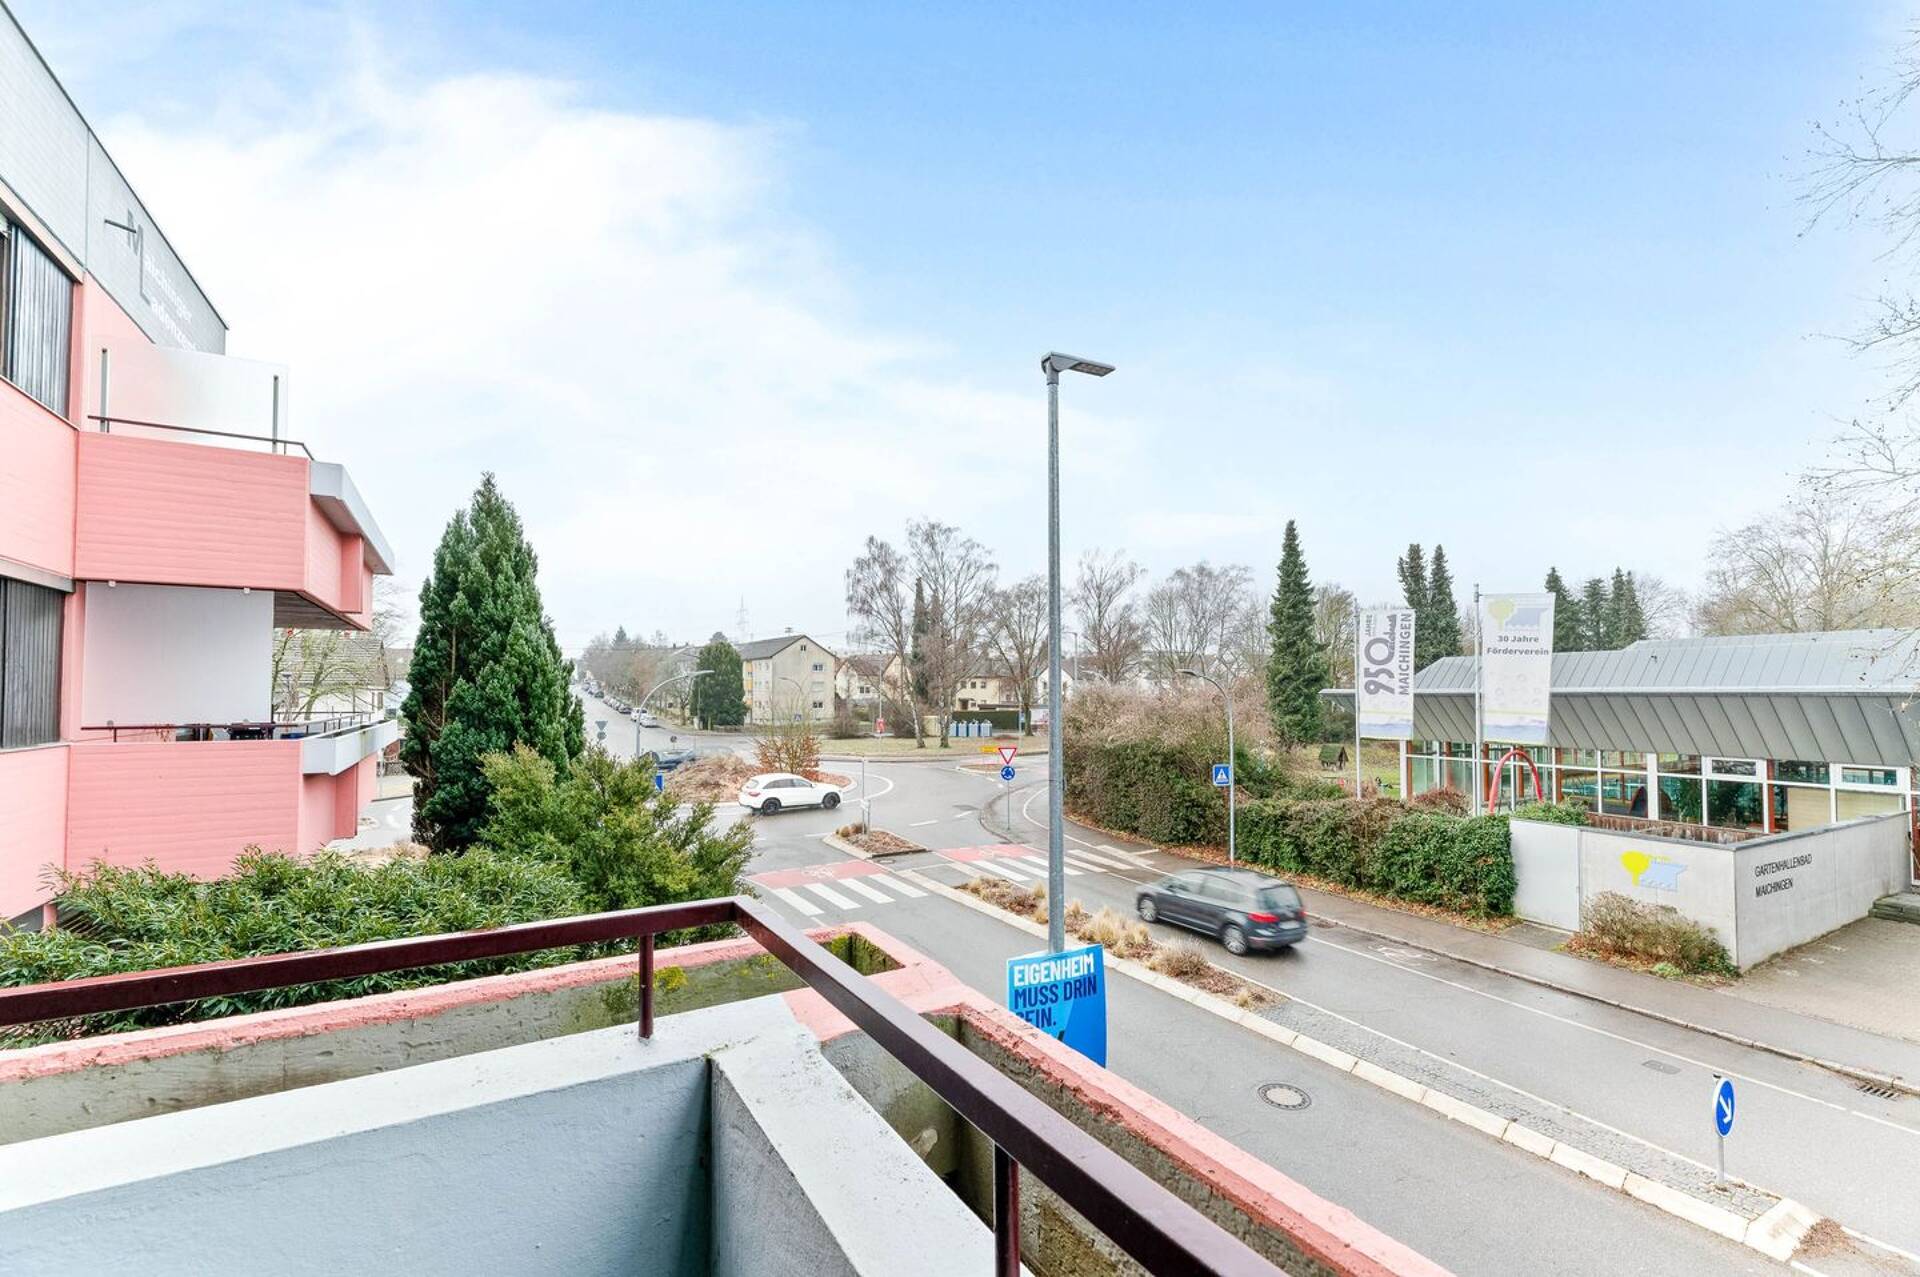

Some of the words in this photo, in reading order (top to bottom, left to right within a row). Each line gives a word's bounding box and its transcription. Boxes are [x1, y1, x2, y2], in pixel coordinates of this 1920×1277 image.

[1487, 646, 1550, 656] Förderverein
[1511, 635, 1540, 643] Jahre
[1364, 637, 1396, 695] 950
[1398, 612, 1412, 696] MAICHINGEN
[1755, 853, 1813, 877] GARTENHALLENBAD
[1755, 878, 1793, 898] MAICHINGEN
[1013, 952, 1095, 987] EIGENHEIM
[1014, 983, 1059, 1010] MUSS
[1063, 974, 1097, 1002] DRIN
